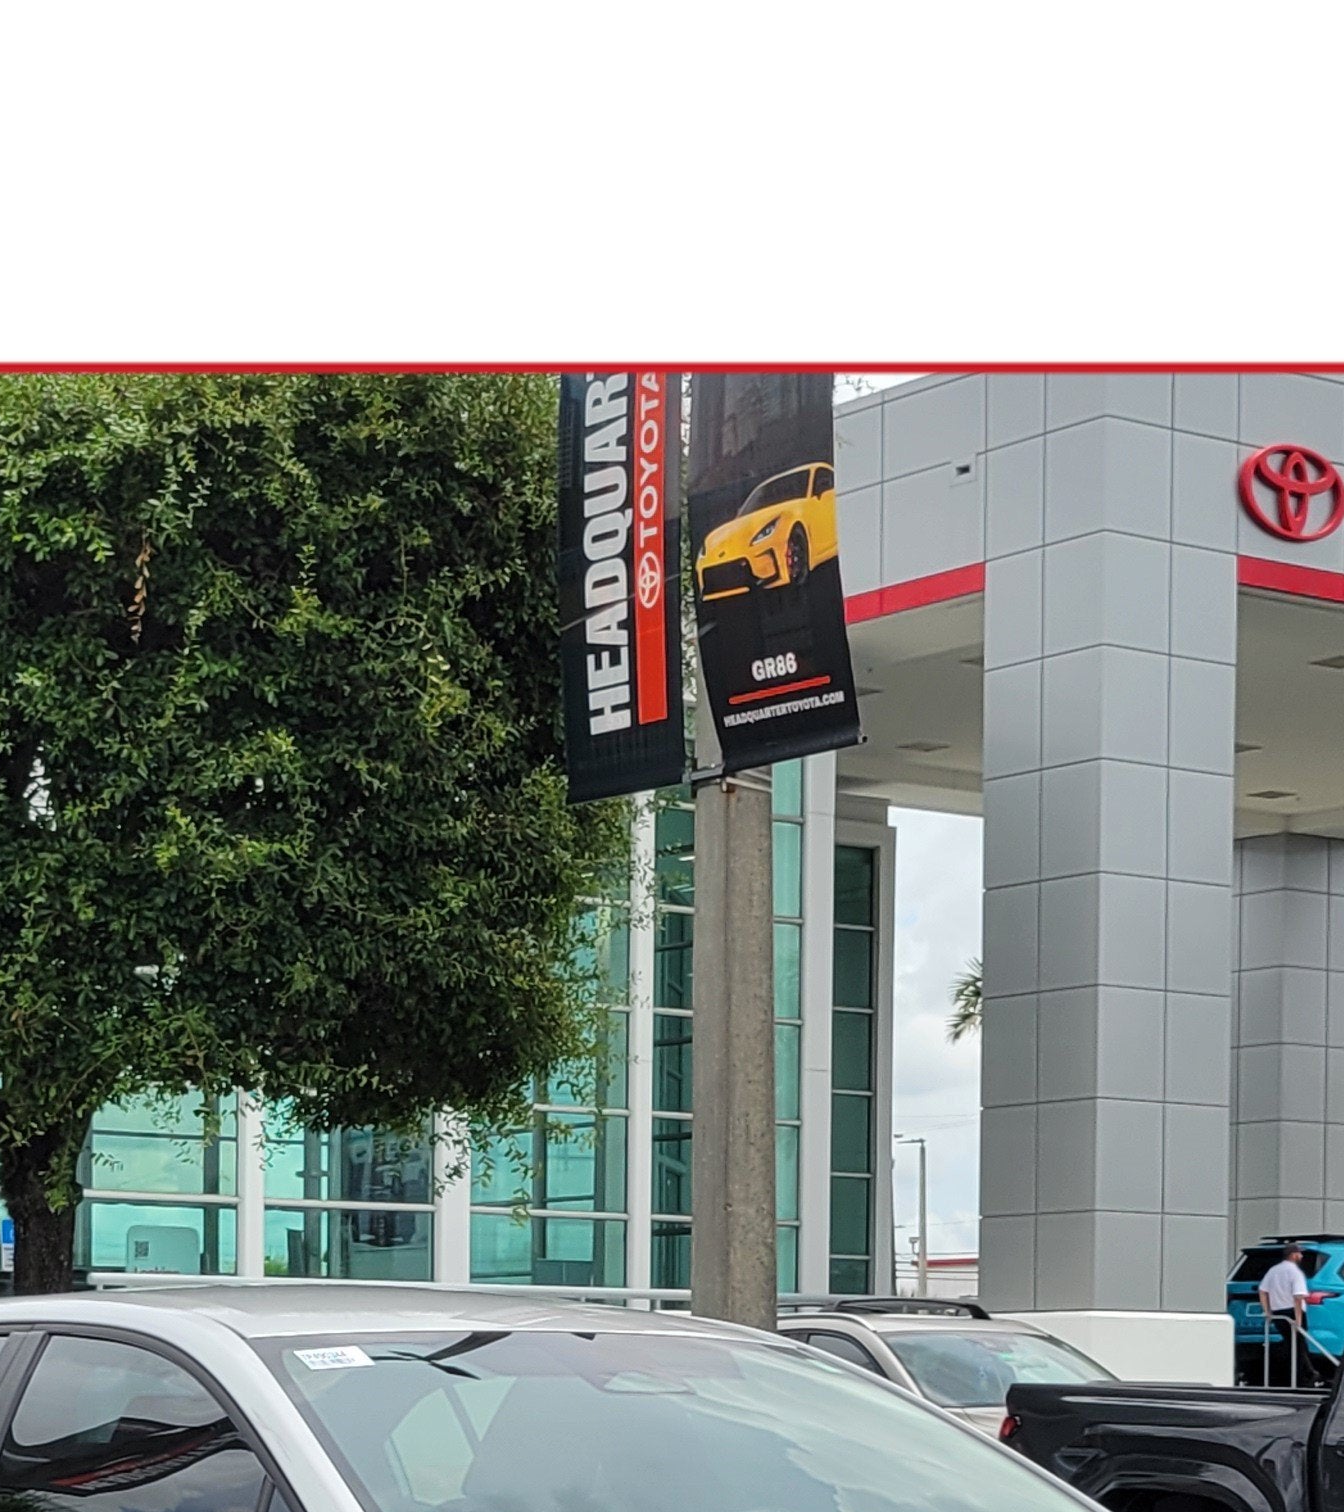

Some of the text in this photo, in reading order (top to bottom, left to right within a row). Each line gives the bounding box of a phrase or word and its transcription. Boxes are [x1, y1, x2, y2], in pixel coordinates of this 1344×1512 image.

[582, 373, 634, 736] HEADQUAR
[751, 651, 798, 682] GR86
[723, 690, 845, 728] HEADQUARTERTOYOTA.COM
